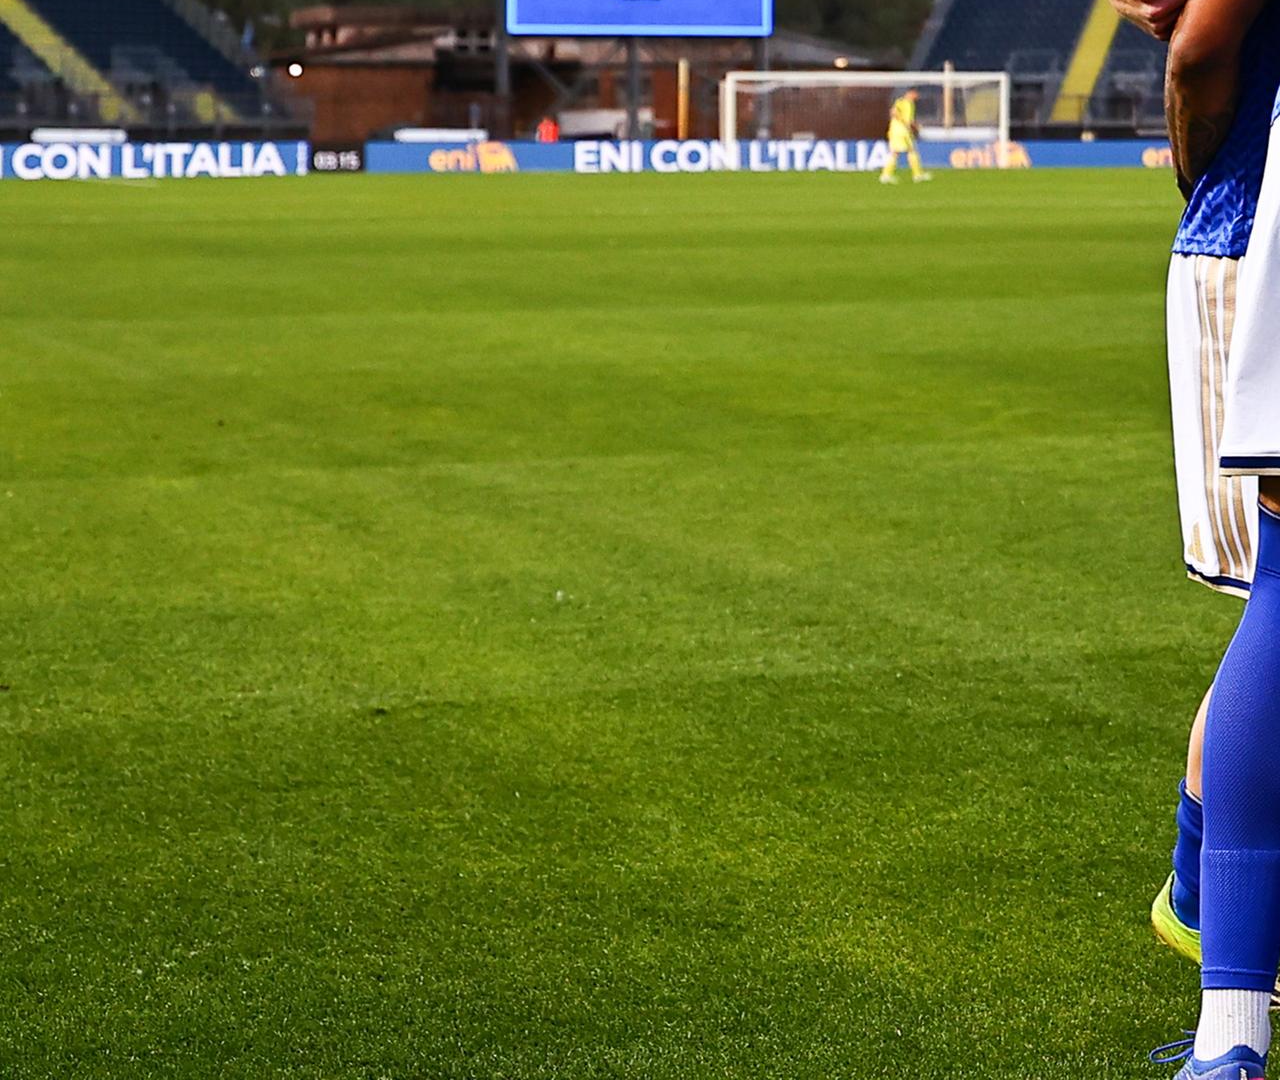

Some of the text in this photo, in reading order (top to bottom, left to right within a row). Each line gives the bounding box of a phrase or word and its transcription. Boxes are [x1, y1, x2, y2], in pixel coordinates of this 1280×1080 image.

[12, 143, 111, 179] CON
[122, 142, 285, 177] L'ITALIA
[428, 146, 477, 171] eni
[574, 140, 889, 172] ENI CON L'ITALIA
[949, 145, 994, 170] eni
[1142, 147, 1172, 168] en
